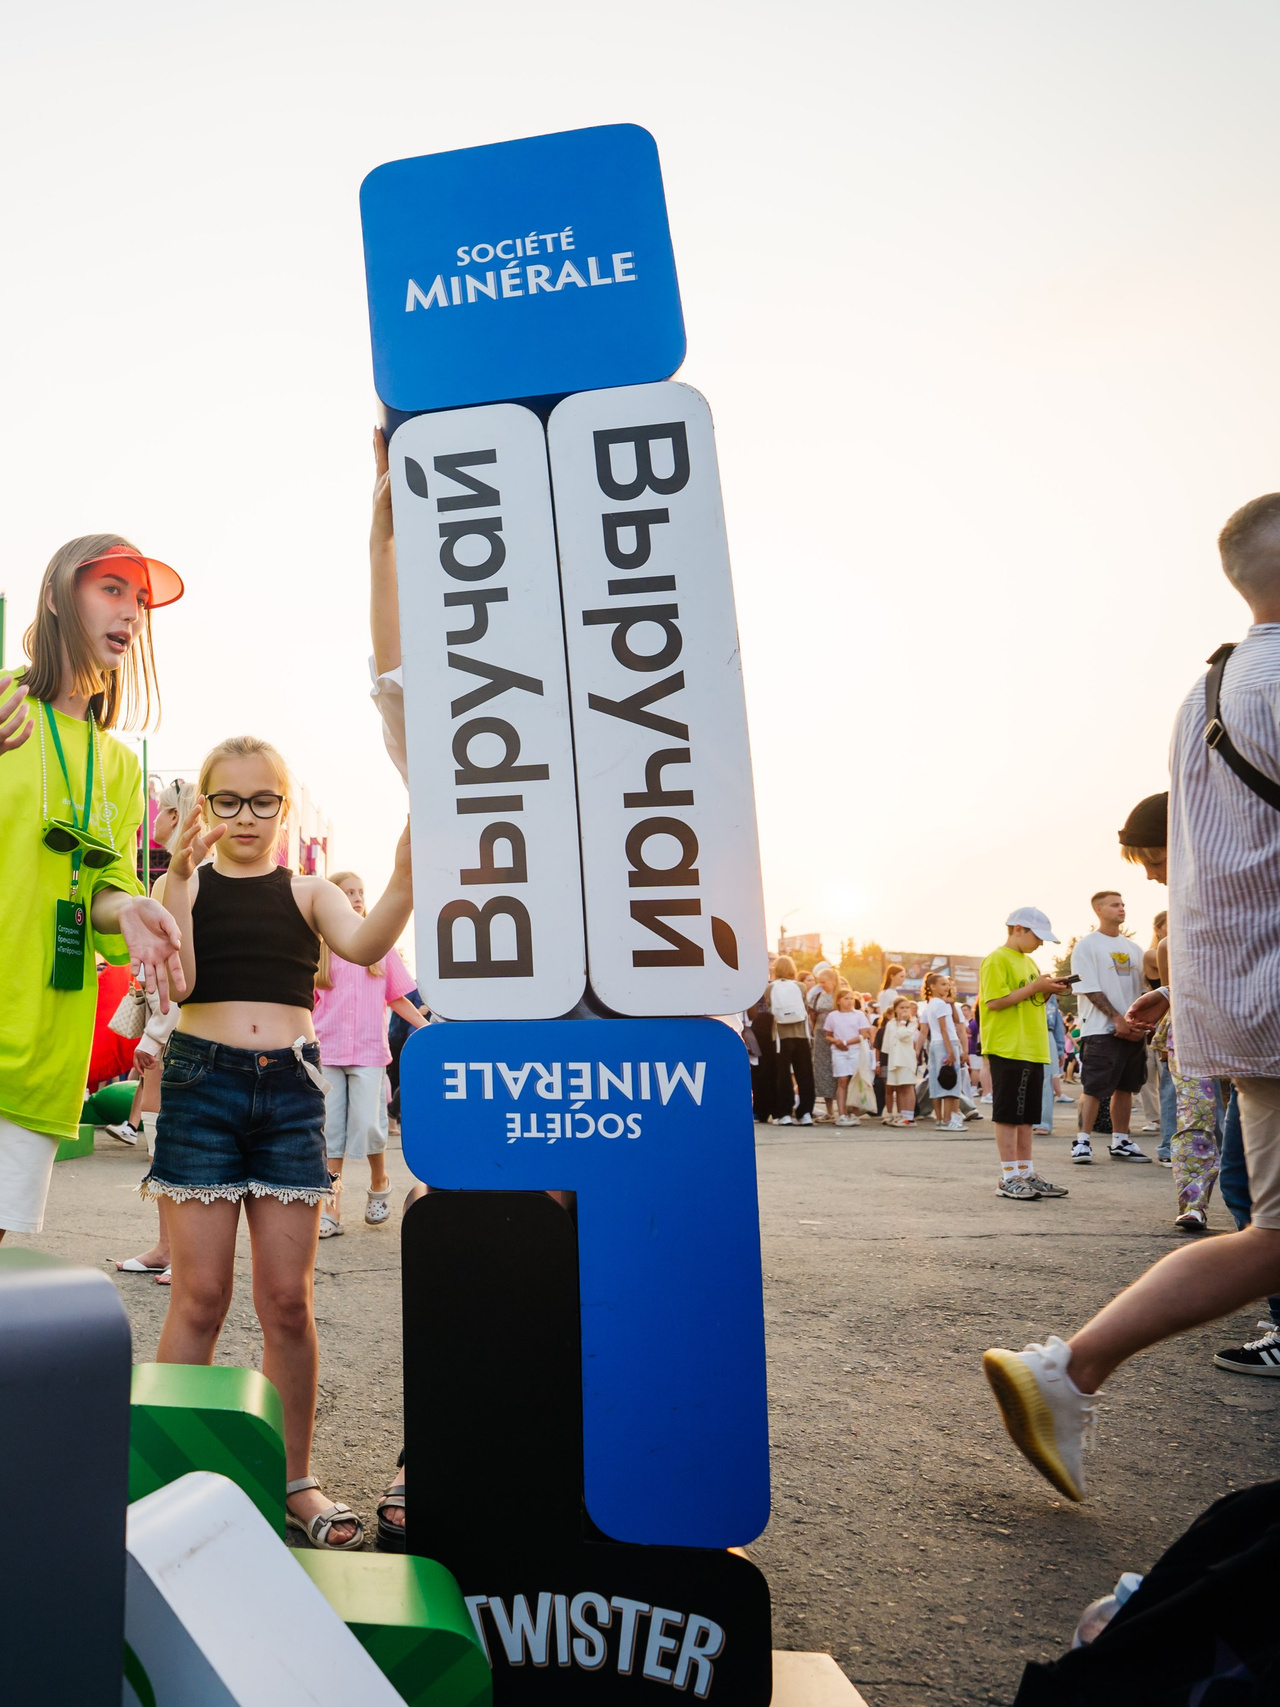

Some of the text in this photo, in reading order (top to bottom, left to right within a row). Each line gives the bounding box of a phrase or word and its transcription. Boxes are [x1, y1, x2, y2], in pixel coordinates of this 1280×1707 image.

[456, 226, 576, 267] SOCIÉTÉ
[404, 251, 639, 313] MINÉRALE
[404, 447, 550, 980] Выручай
[581, 420, 740, 972] Выручай
[442, 1061, 707, 1110] MINÉRALE
[505, 1112, 643, 1144] SOCIÉTÉ
[463, 1591, 726, 1700] TWISTER
